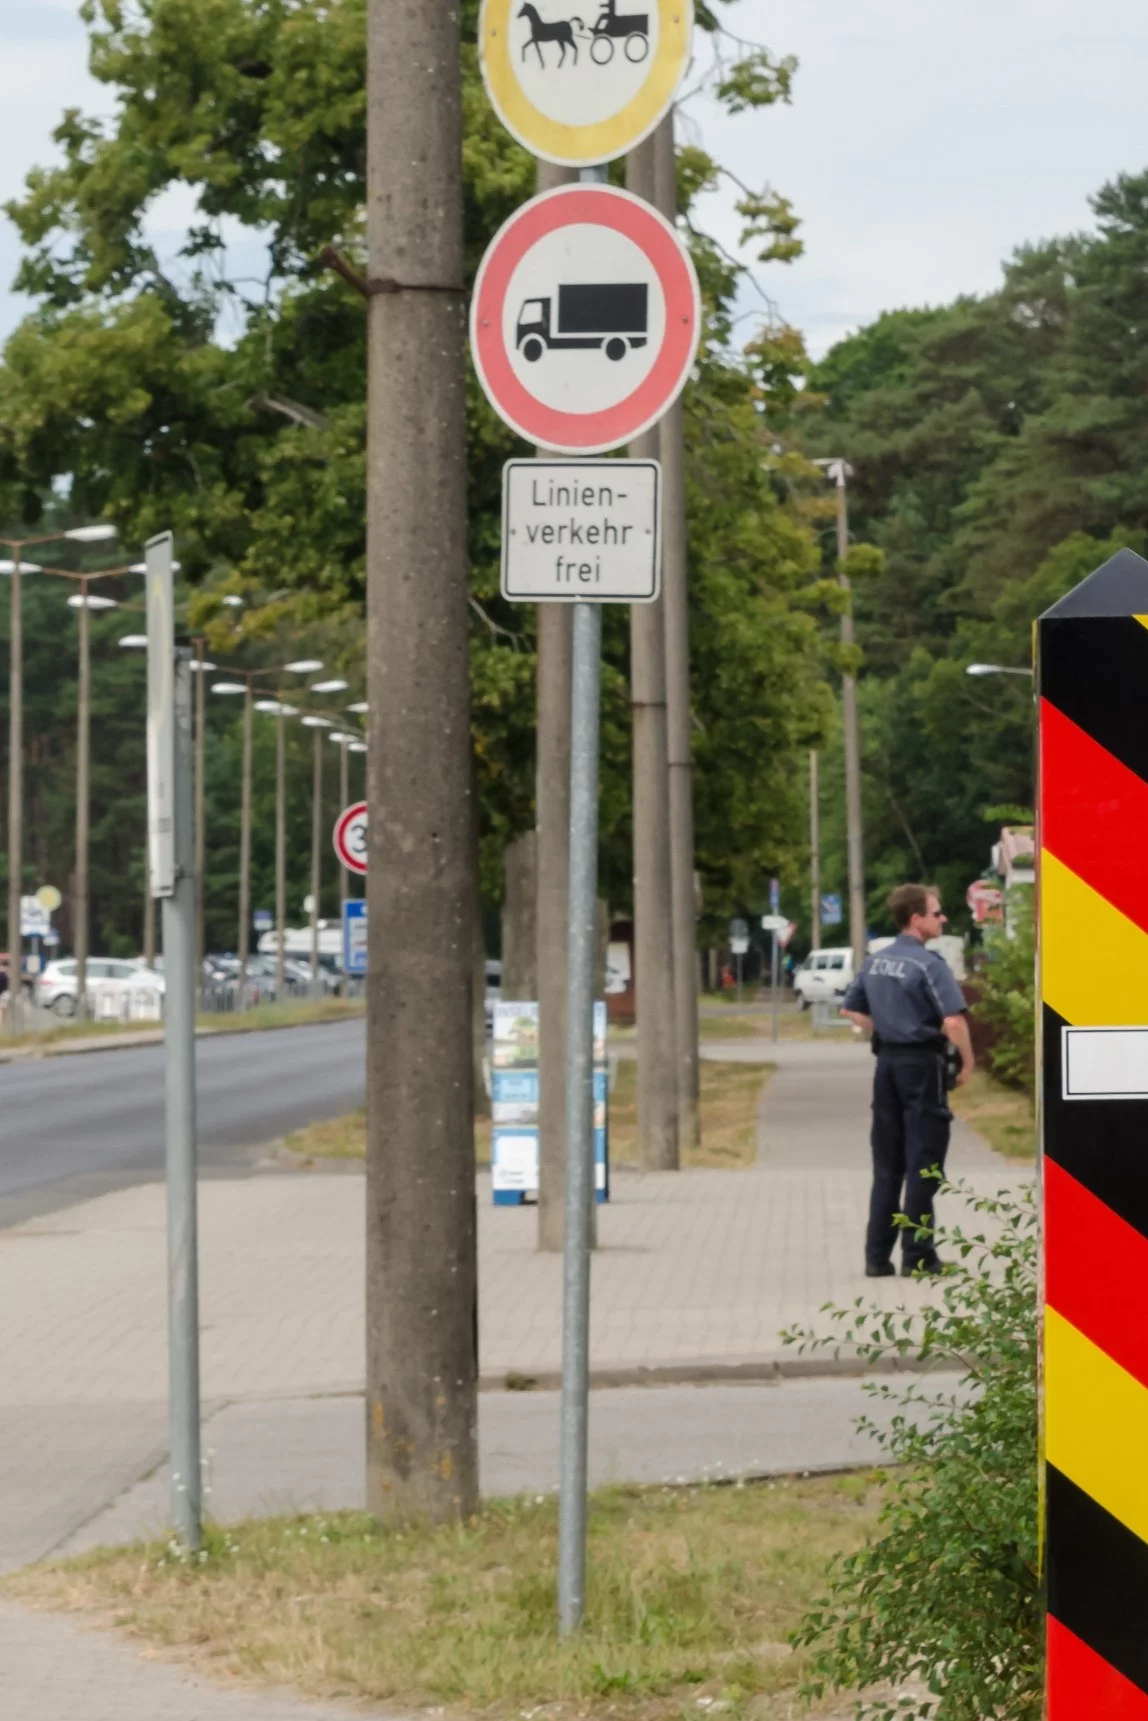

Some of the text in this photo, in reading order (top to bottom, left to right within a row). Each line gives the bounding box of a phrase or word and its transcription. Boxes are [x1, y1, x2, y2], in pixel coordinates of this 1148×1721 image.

[532, 479, 628, 507] Linien-
[526, 517, 634, 545] verkehr
[555, 555, 601, 583] frei
[351, 824, 368, 853] 3
